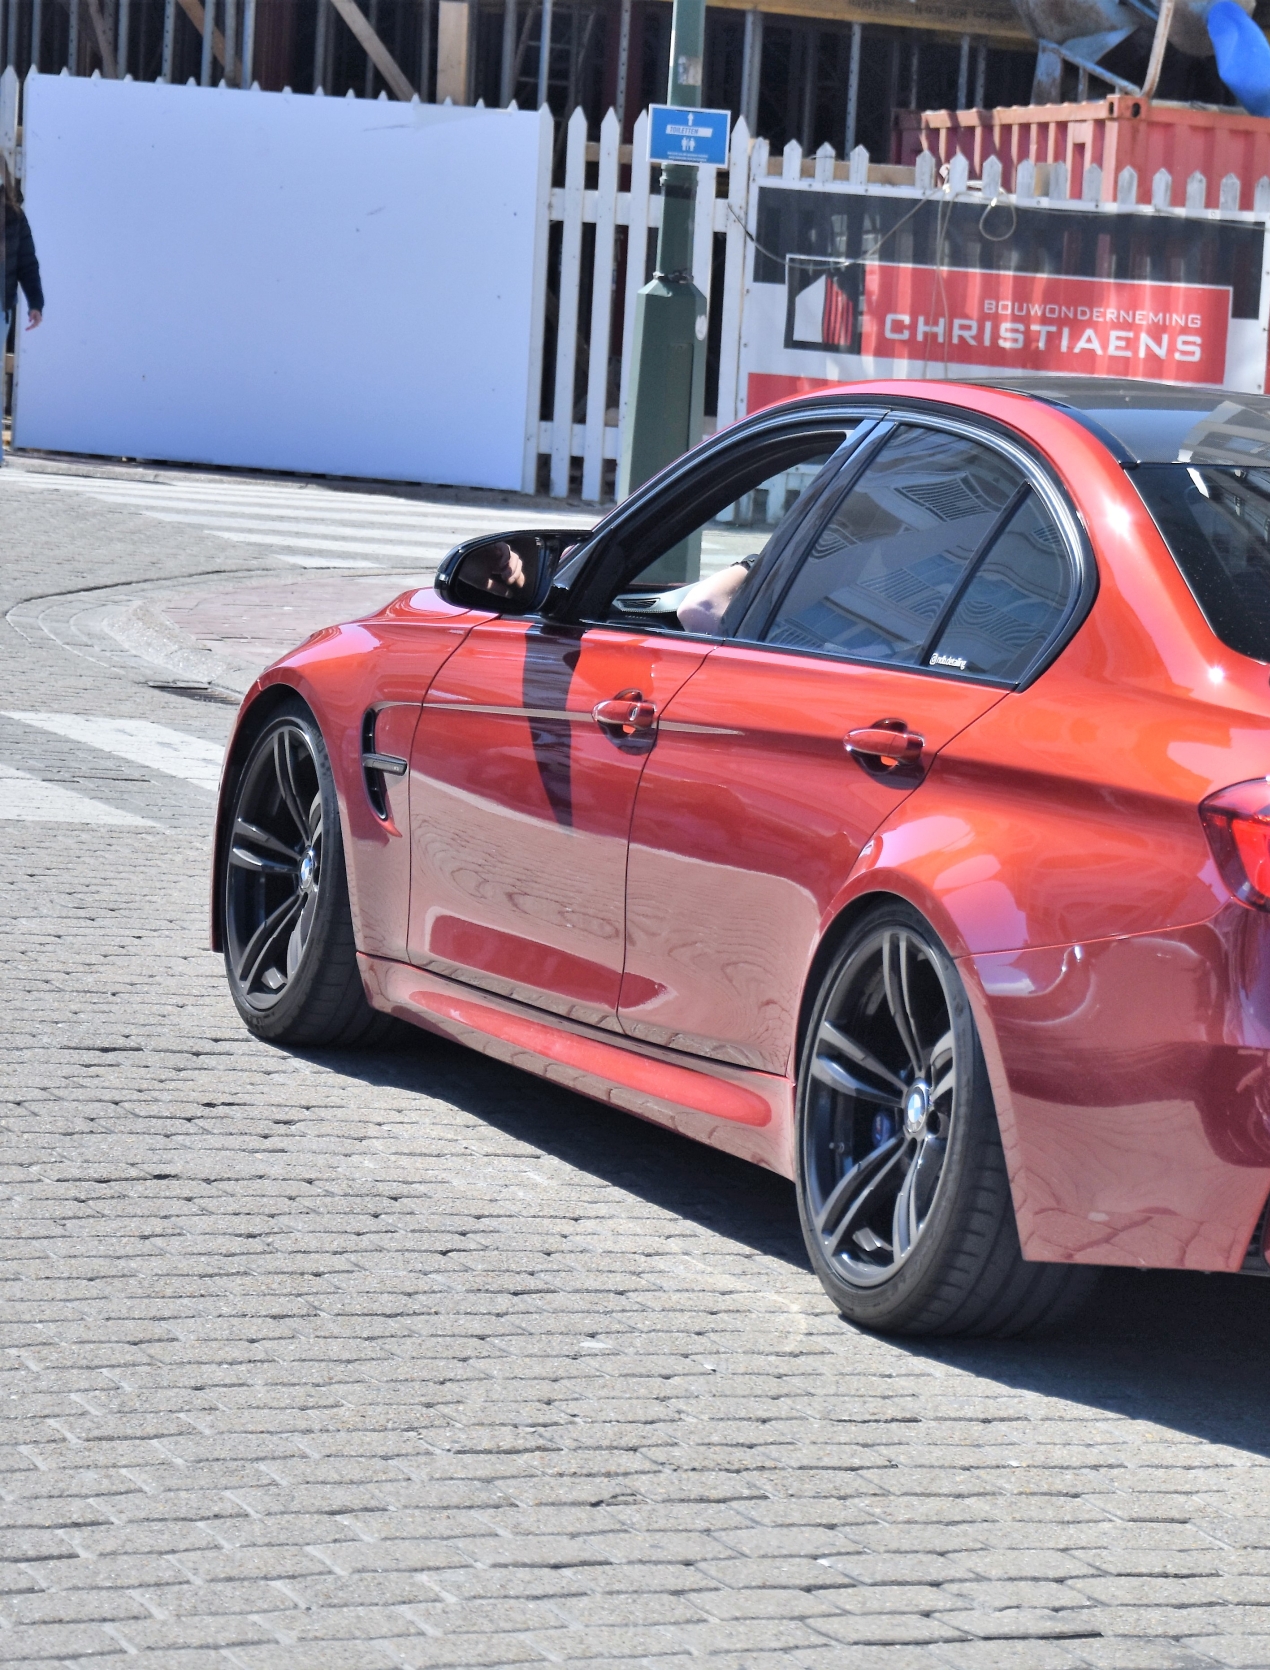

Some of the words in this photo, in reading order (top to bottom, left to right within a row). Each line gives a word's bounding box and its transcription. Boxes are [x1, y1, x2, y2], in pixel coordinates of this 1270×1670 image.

[669, 126, 699, 135] TOILETTEN
[984, 299, 1201, 328] BOUWONDERNEMING
[884, 313, 1202, 363] CHRISTIAENS
